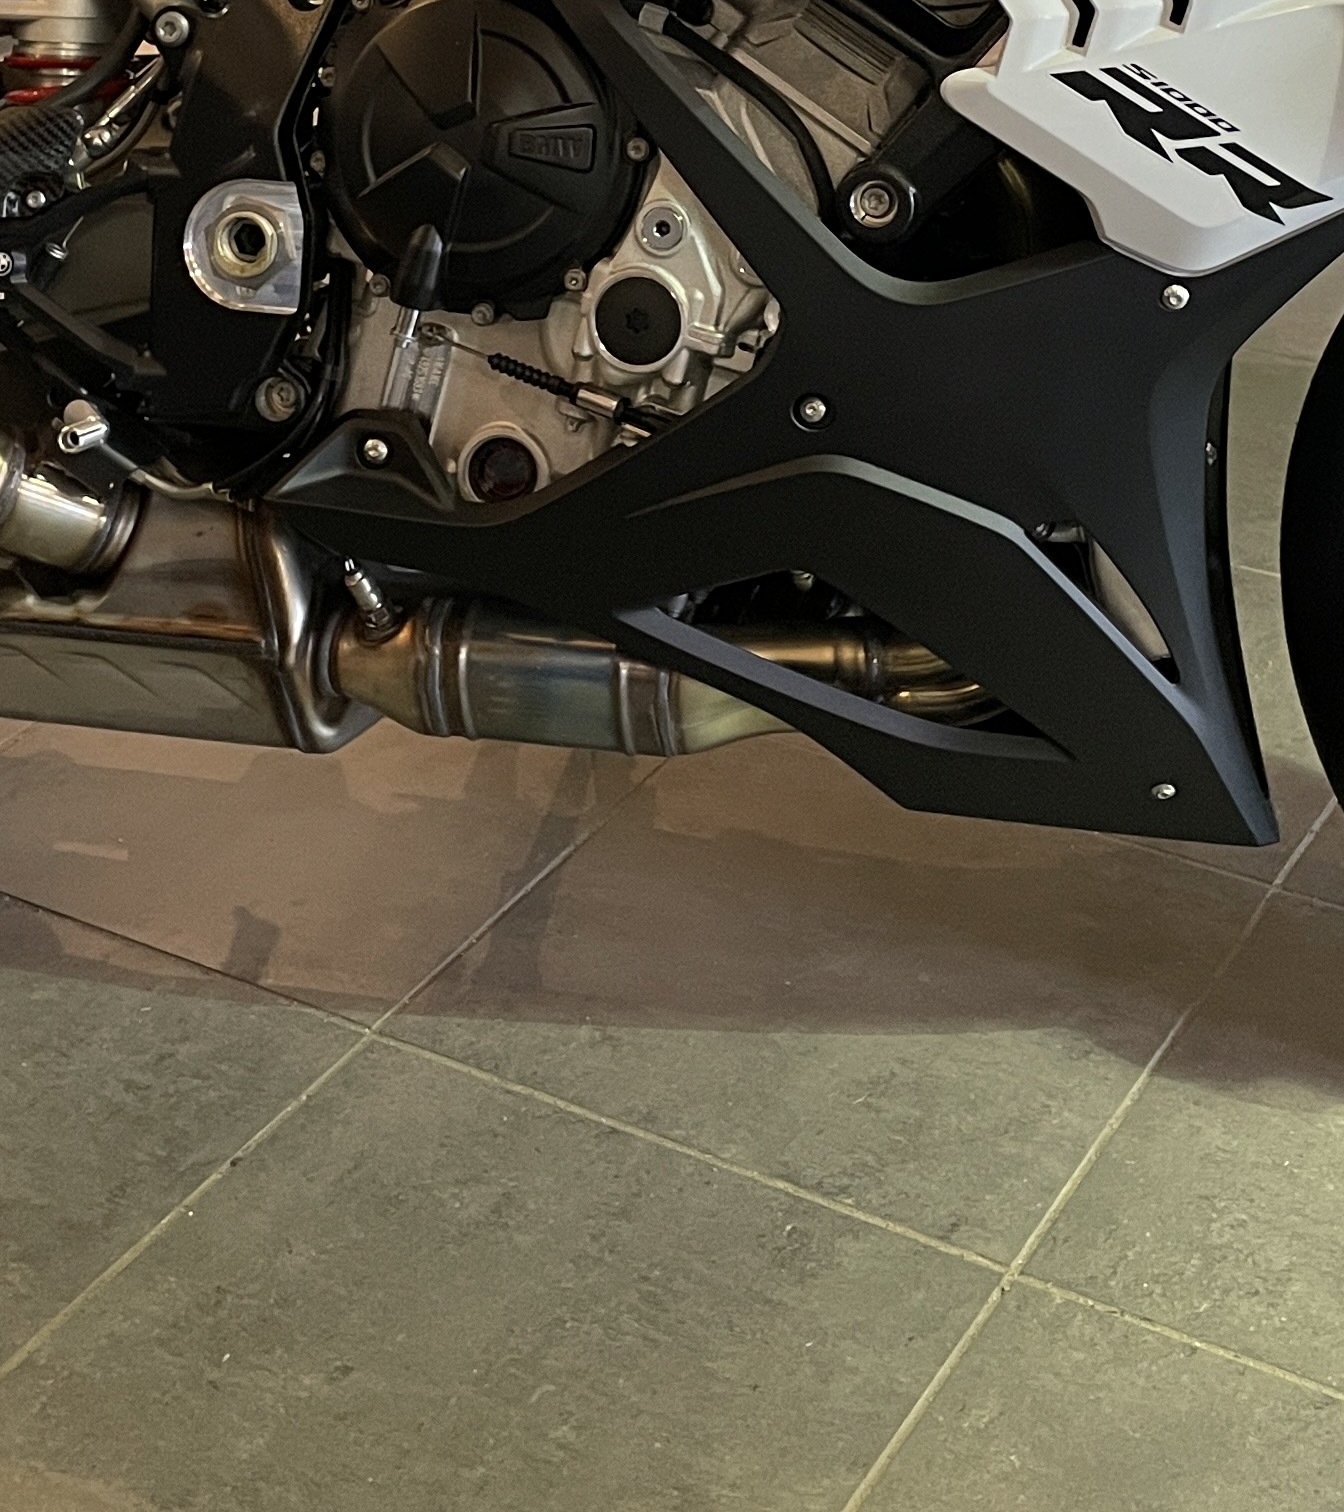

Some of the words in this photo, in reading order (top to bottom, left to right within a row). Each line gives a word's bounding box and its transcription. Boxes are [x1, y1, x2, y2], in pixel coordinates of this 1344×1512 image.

[1122, 63, 1241, 133] S1000
[519, 133, 585, 158] BMW
[1049, 66, 1335, 226] RR
